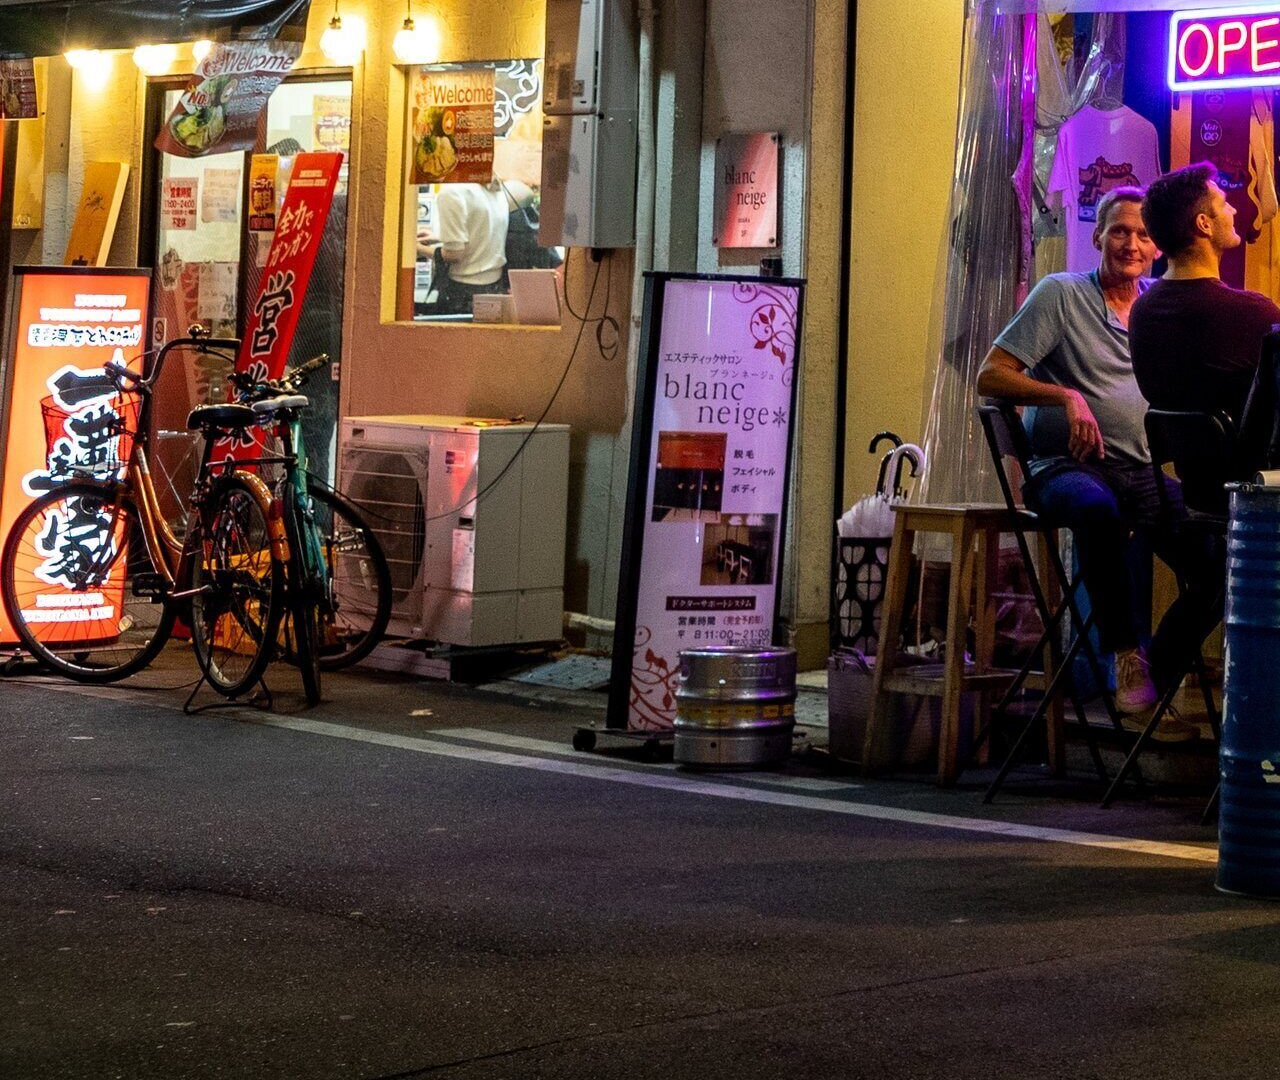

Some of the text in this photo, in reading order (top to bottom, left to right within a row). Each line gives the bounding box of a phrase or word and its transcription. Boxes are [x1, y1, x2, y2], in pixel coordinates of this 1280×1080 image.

[223, 49, 296, 72] Welcome
[433, 84, 494, 105] Welcome
[724, 165, 756, 185] blanc
[736, 186, 767, 211] neige
[278, 200, 314, 238] 全力で
[664, 352, 743, 365] エステティックサロン
[664, 372, 745, 402] blanc
[697, 402, 770, 432] neige
[733, 448, 755, 460] 脱毛
[732, 466, 776, 477] フェイシャル
[731, 484, 757, 494] ボディ
[678, 615, 717, 626] 営業時間
